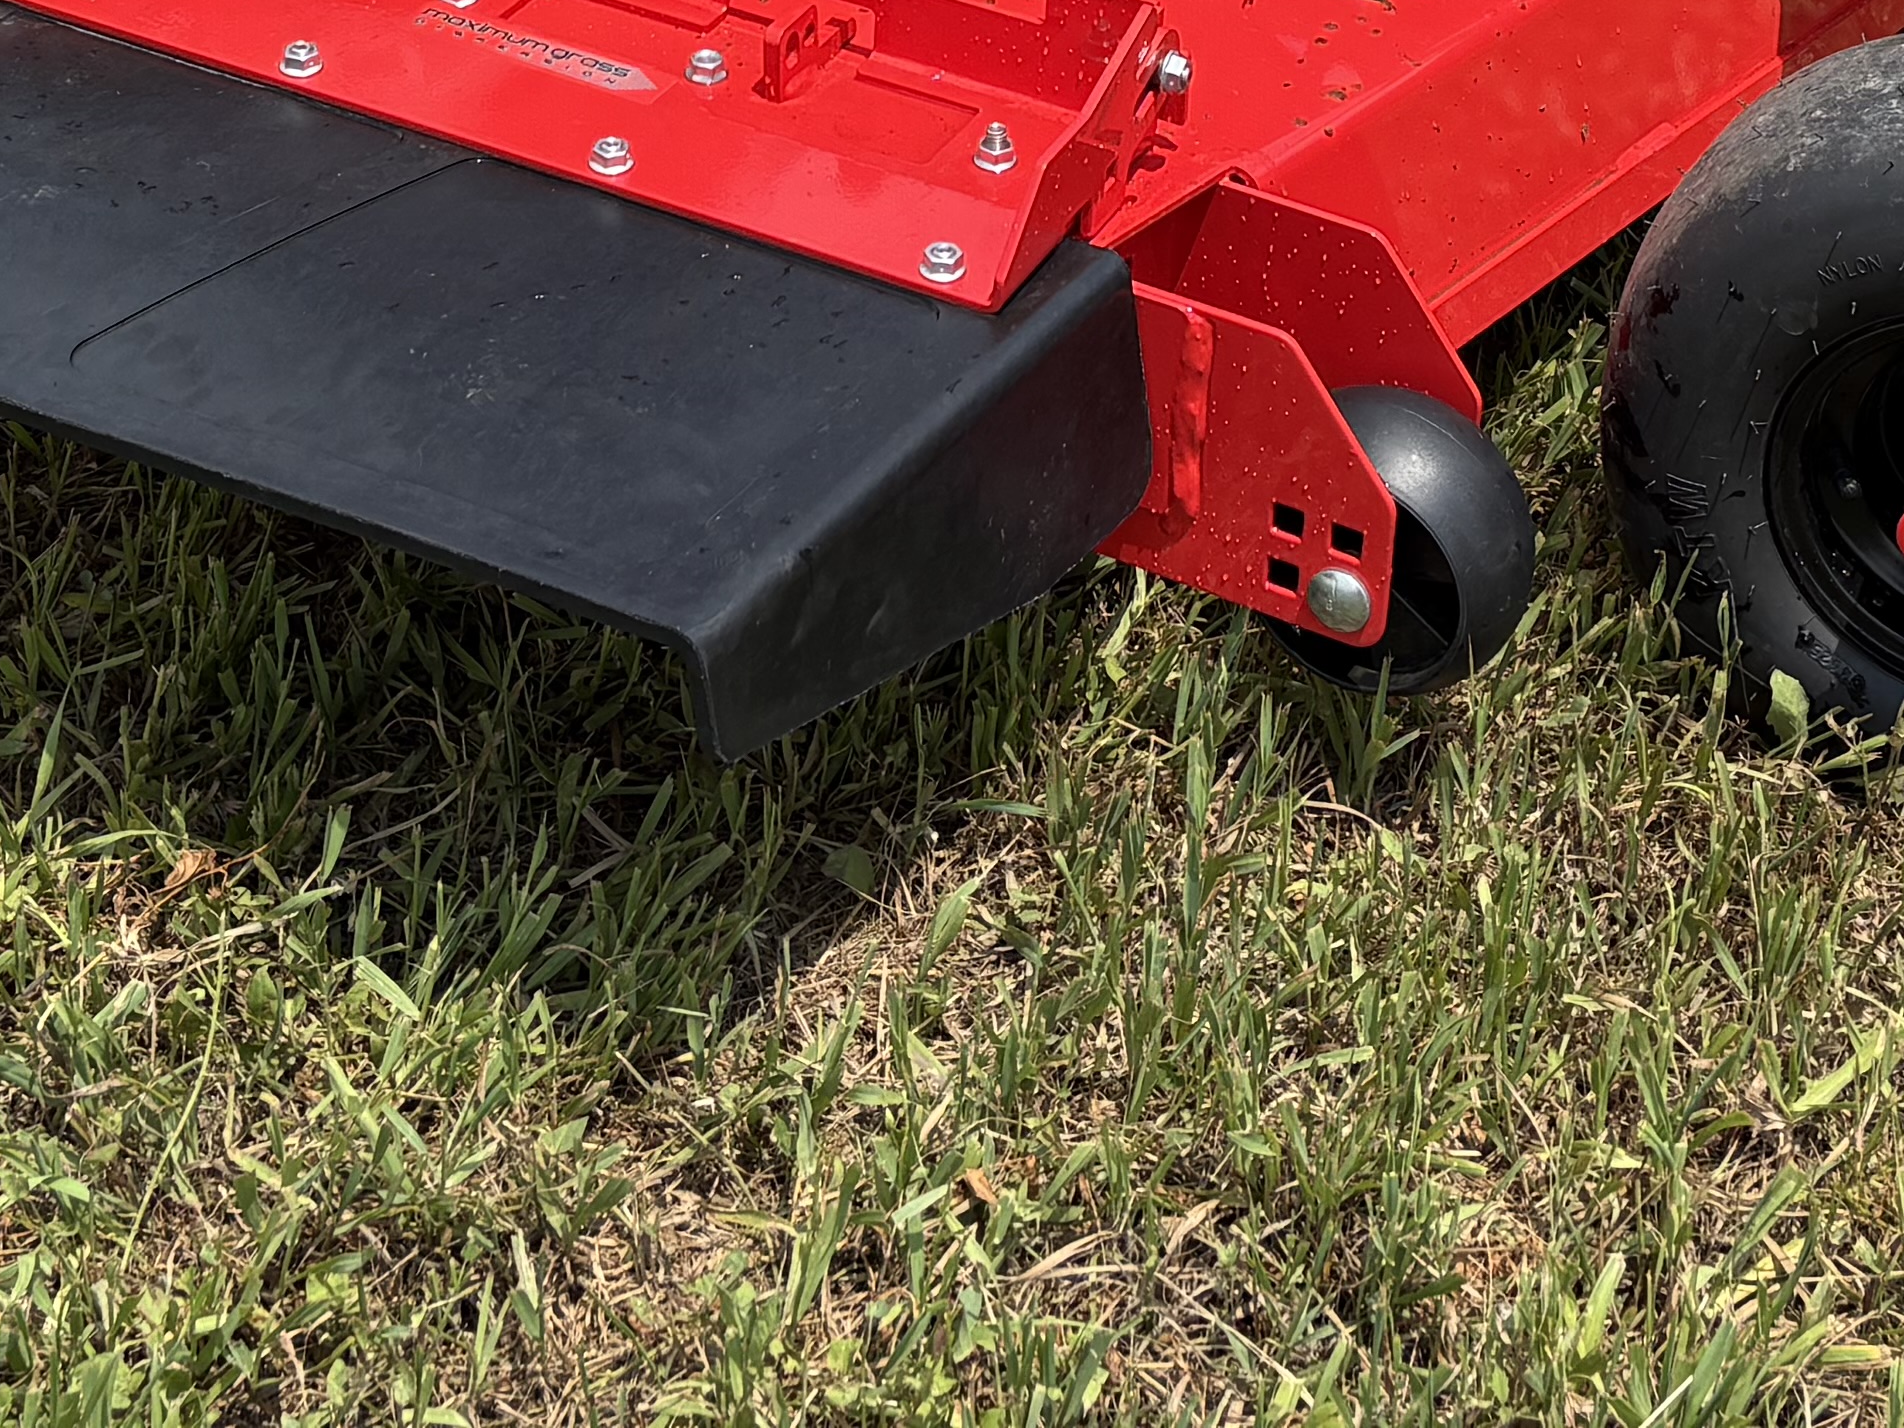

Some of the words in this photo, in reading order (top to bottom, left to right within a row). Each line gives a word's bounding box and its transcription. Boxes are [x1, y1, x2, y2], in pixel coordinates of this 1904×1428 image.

[421, 7, 549, 53] maximum
[550, 46, 631, 79] grass
[1817, 253, 1884, 286] NYLON
